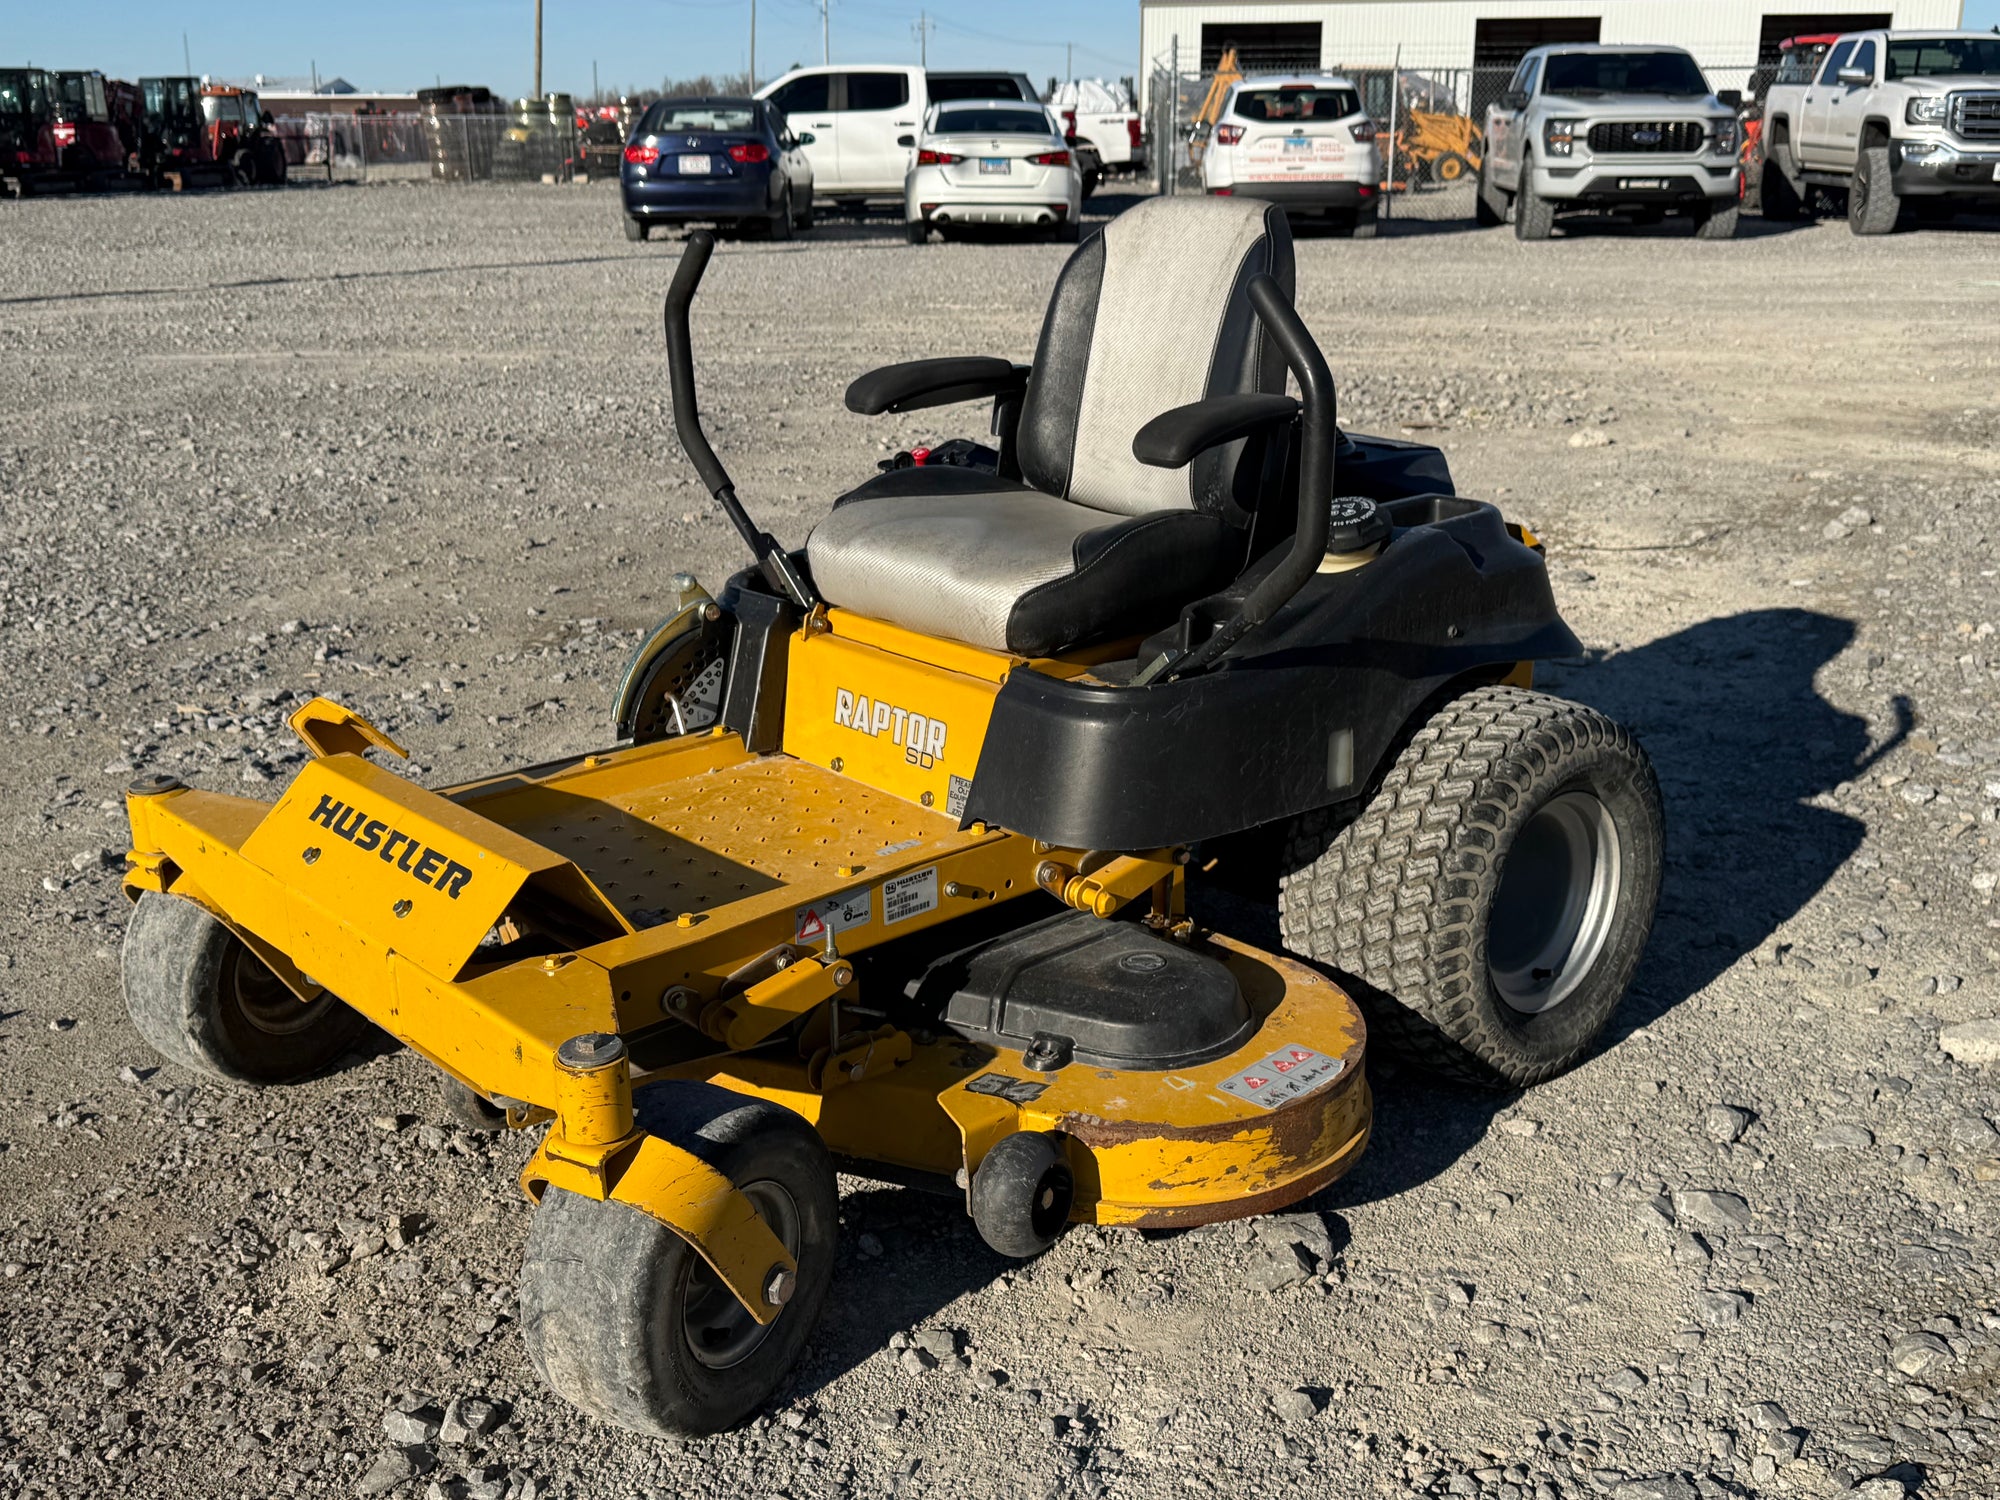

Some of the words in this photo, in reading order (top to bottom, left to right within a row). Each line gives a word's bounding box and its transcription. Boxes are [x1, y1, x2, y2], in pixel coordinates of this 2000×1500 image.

[834, 687, 948, 761] RAPTOR
[905, 746, 934, 770] SD
[308, 793, 473, 900] HUSTLER
